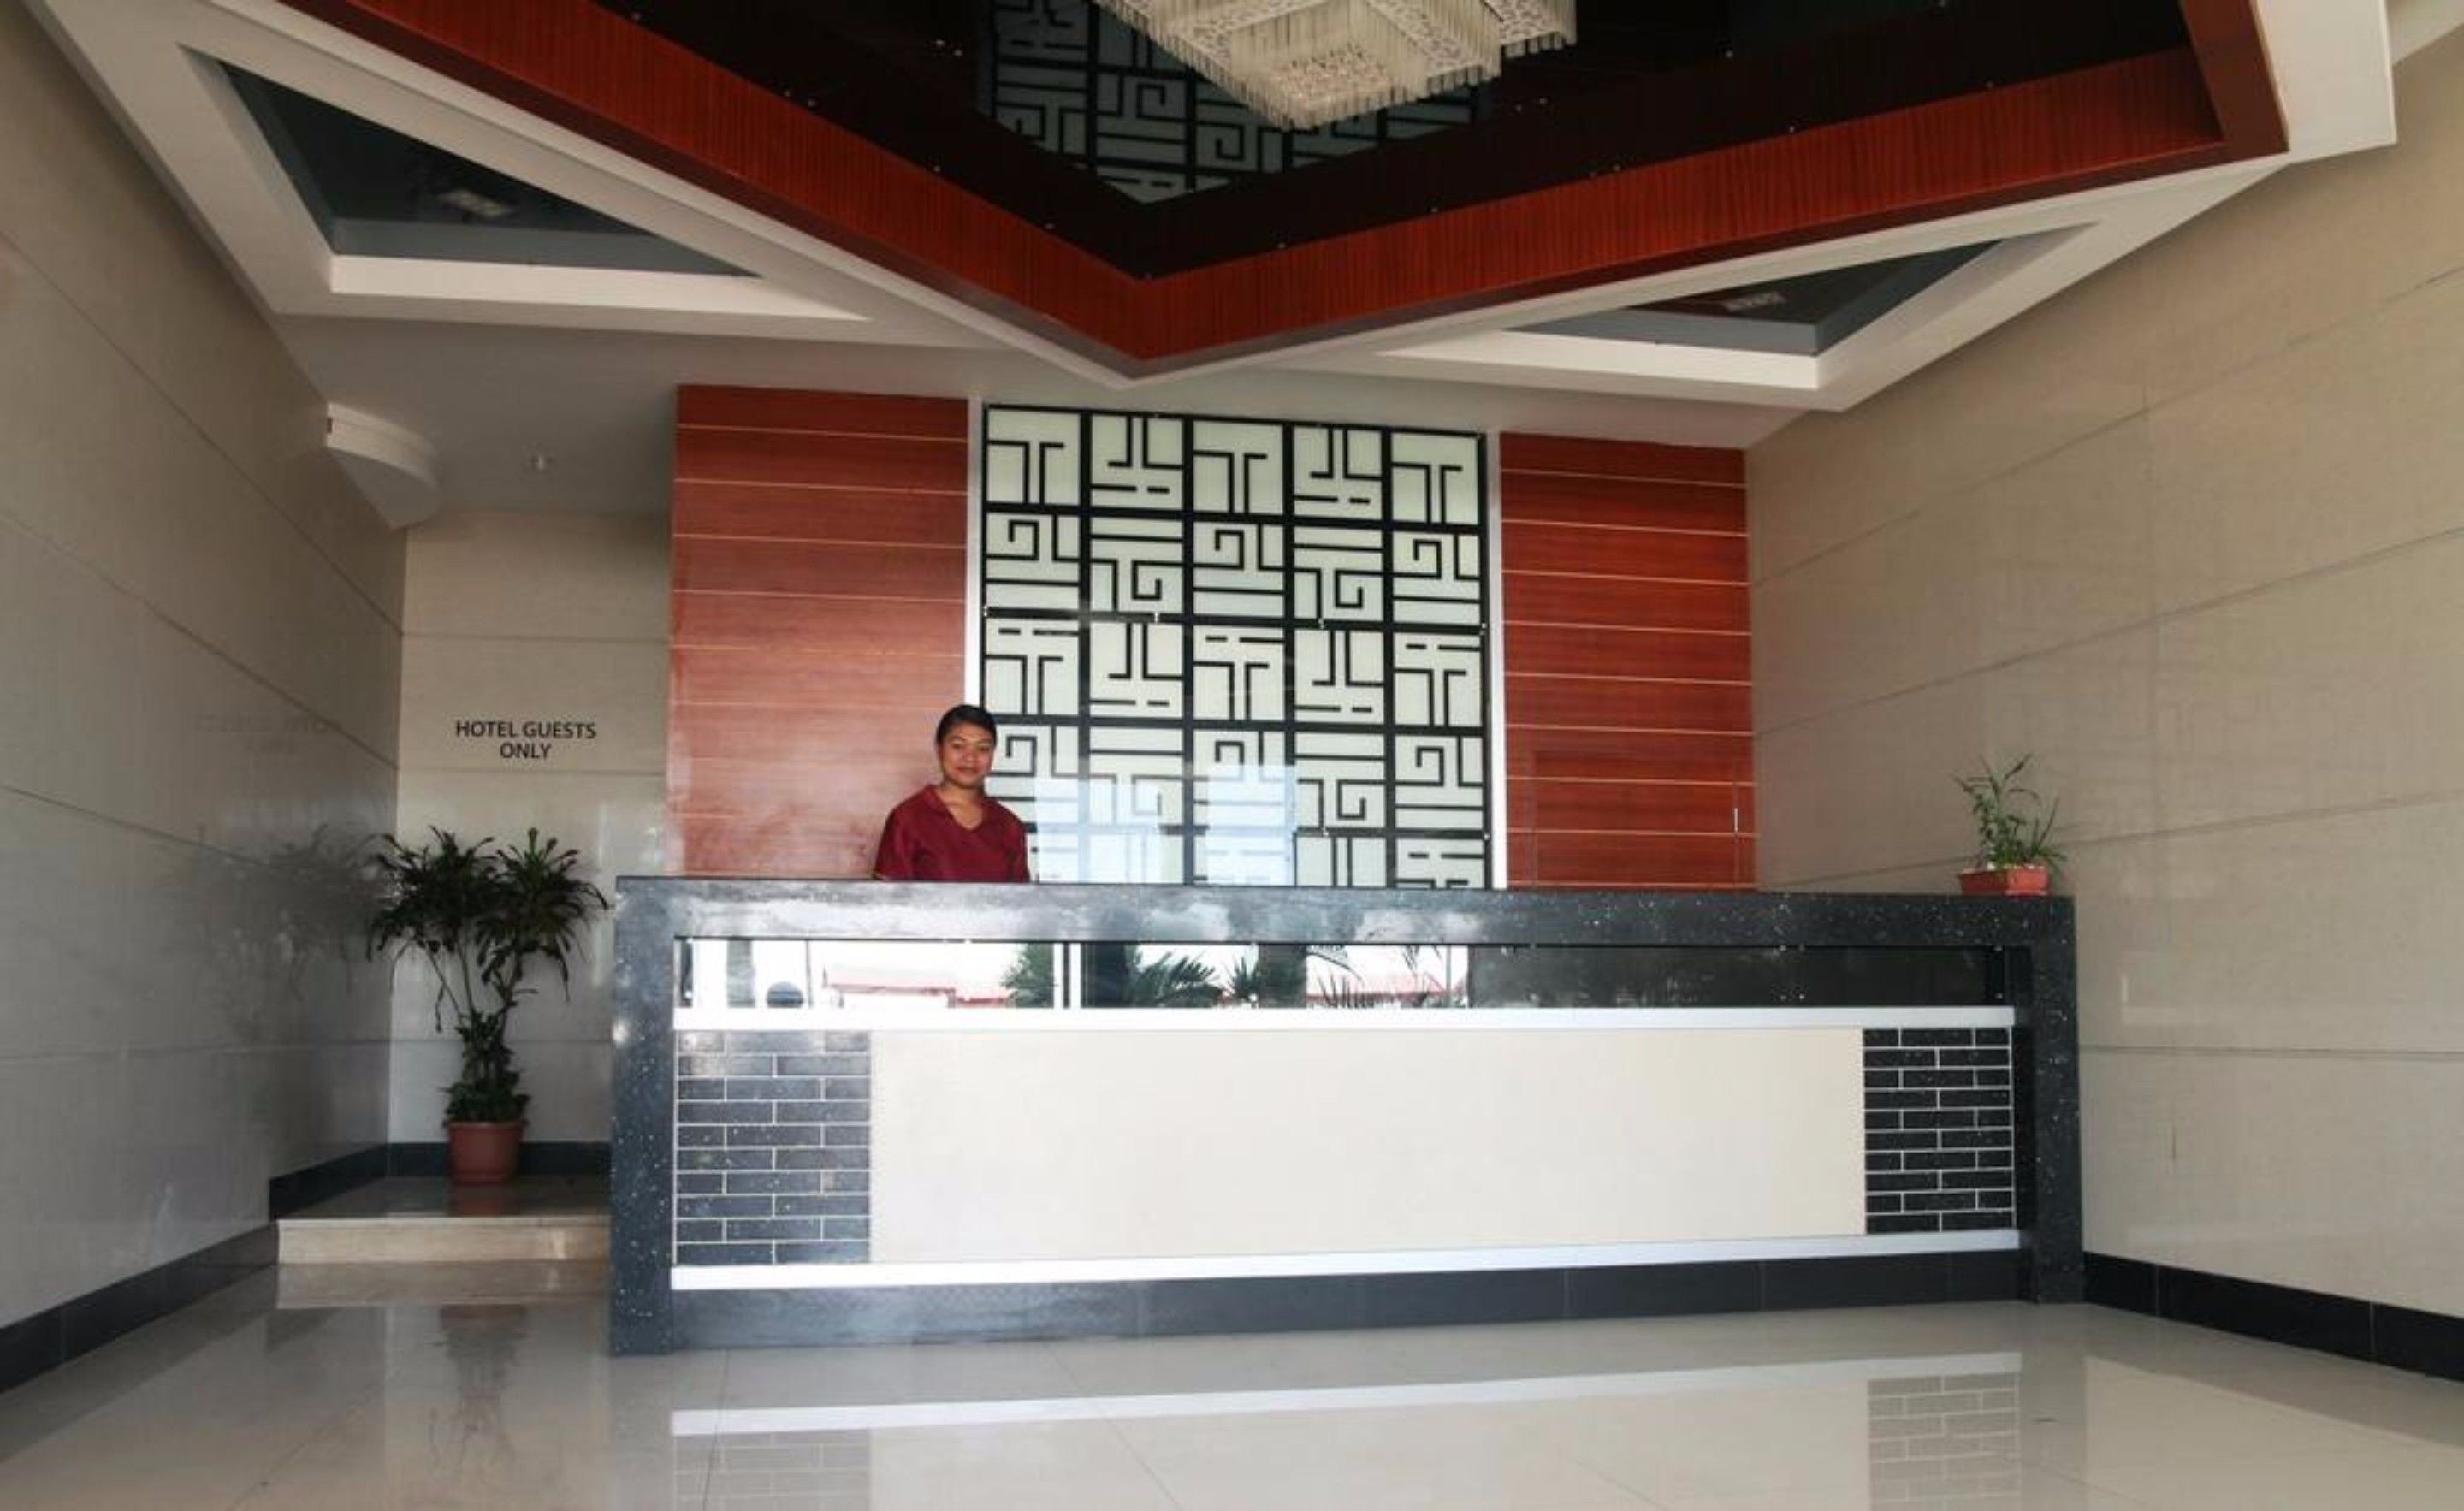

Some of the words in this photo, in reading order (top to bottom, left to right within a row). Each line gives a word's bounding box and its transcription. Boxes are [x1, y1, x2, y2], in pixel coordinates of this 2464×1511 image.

[455, 720, 518, 738] HOTEL
[522, 721, 598, 739] GUESTS
[500, 742, 553, 760] ONLY
